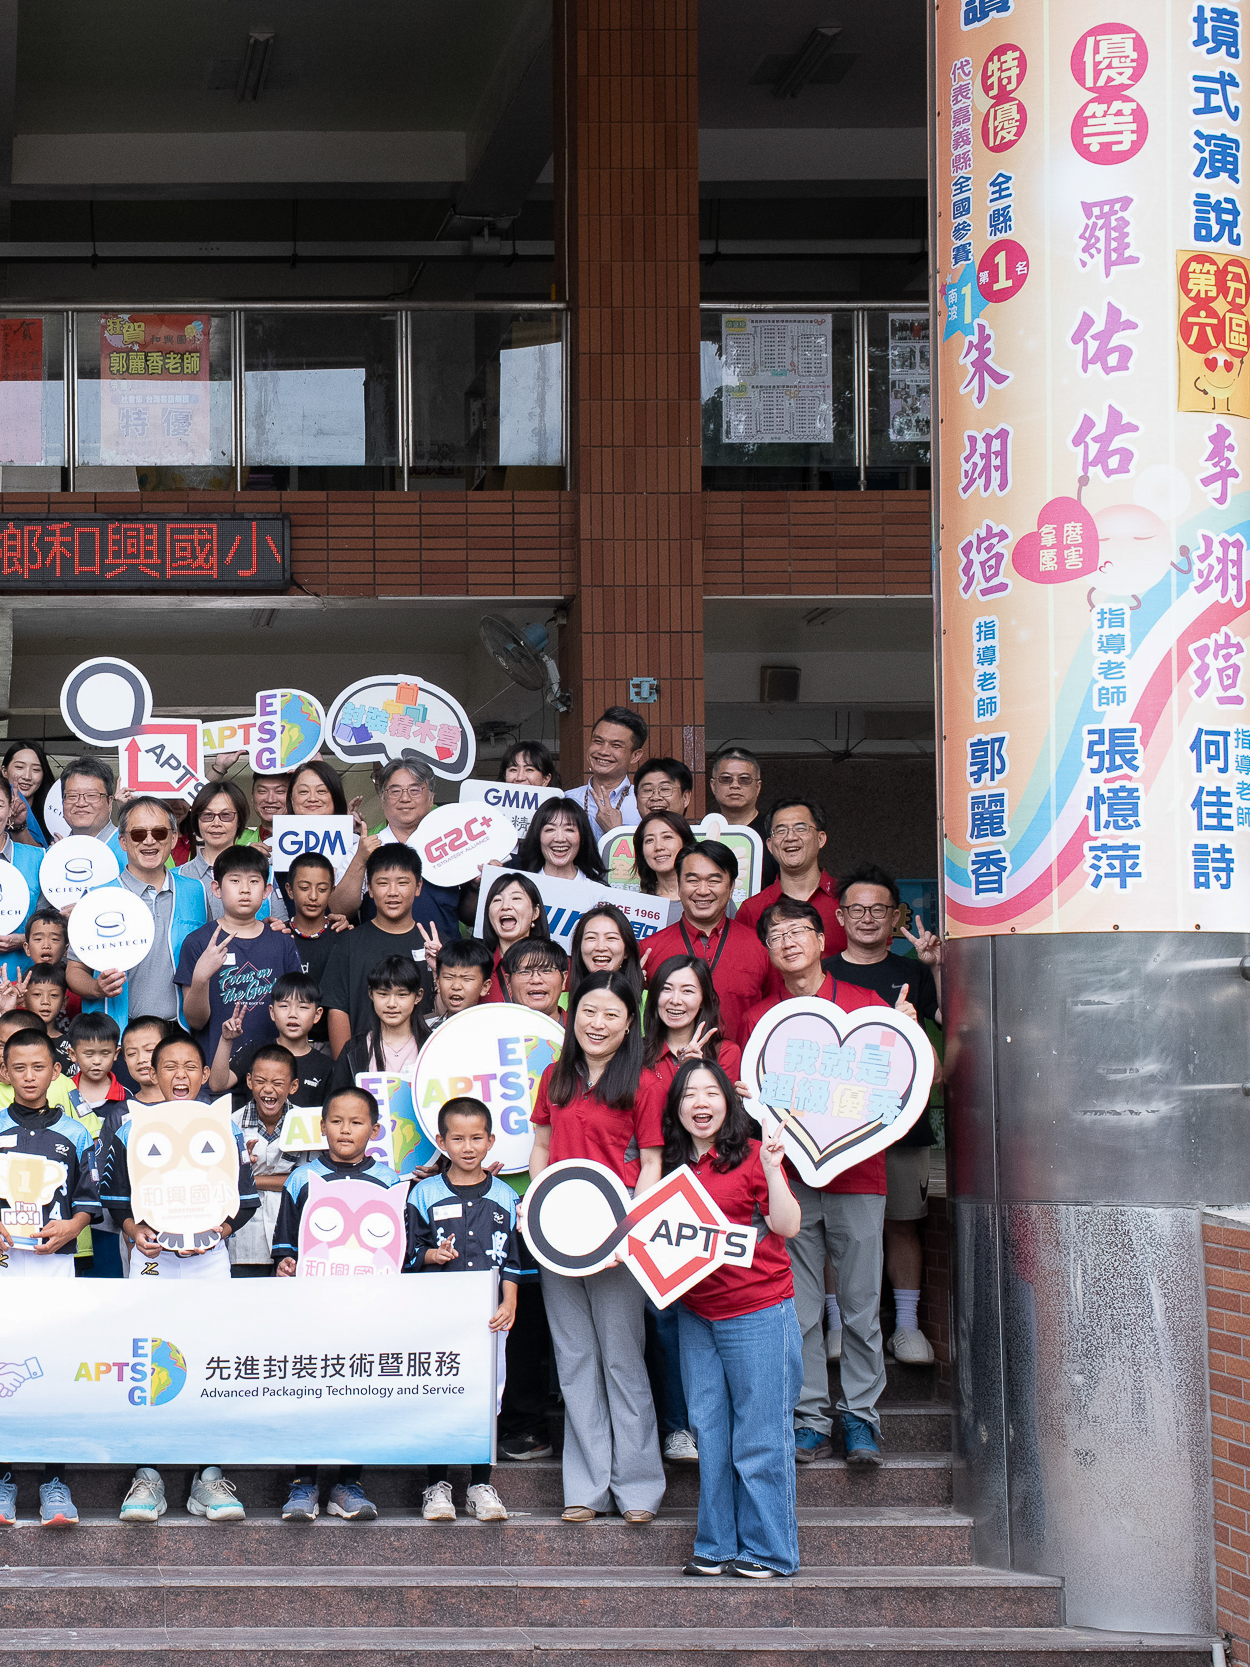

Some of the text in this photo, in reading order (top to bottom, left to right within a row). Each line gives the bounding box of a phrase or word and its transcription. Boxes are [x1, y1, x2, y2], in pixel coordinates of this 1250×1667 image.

[987, 50, 1021, 148] 特優
[1082, 33, 1138, 153] 優等
[1192, 5, 1241, 247] 境式演說
[950, 59, 973, 267] 代表嘉義縣全國參賽
[988, 172, 1014, 237] 全縣
[978, 250, 1028, 291] 第1名
[1070, 195, 1142, 480] 羅佑佑
[109, 351, 201, 375] 郭麗香老師
[340, 701, 462, 752] 封裝積木營
[1086, 606, 1143, 889] 指導老師 張憶萍
[968, 620, 1008, 896] 指導老師 郭麗香
[484, 788, 539, 811] GMM
[1189, 727, 1234, 890] 何佳詩
[278, 830, 347, 856] GDM
[634, 908, 661, 921] 1966
[79, 938, 149, 951] SCIENTECH
[219, 966, 256, 991] Focus
[497, 1036, 529, 1136] ESG
[784, 1038, 892, 1087] 我就是
[758, 1071, 903, 1126] 超級優秀
[18, 1170, 30, 1193] 1
[143, 1183, 234, 1207] 和興國小
[649, 1219, 748, 1258] APTS
[74, 1361, 148, 1382] APTS
[128, 1338, 149, 1406] ESG
[205, 1351, 462, 1381] 先進封裝技術暨服務
[200, 1383, 465, 1399] Advanced Packaging Technology and Service
